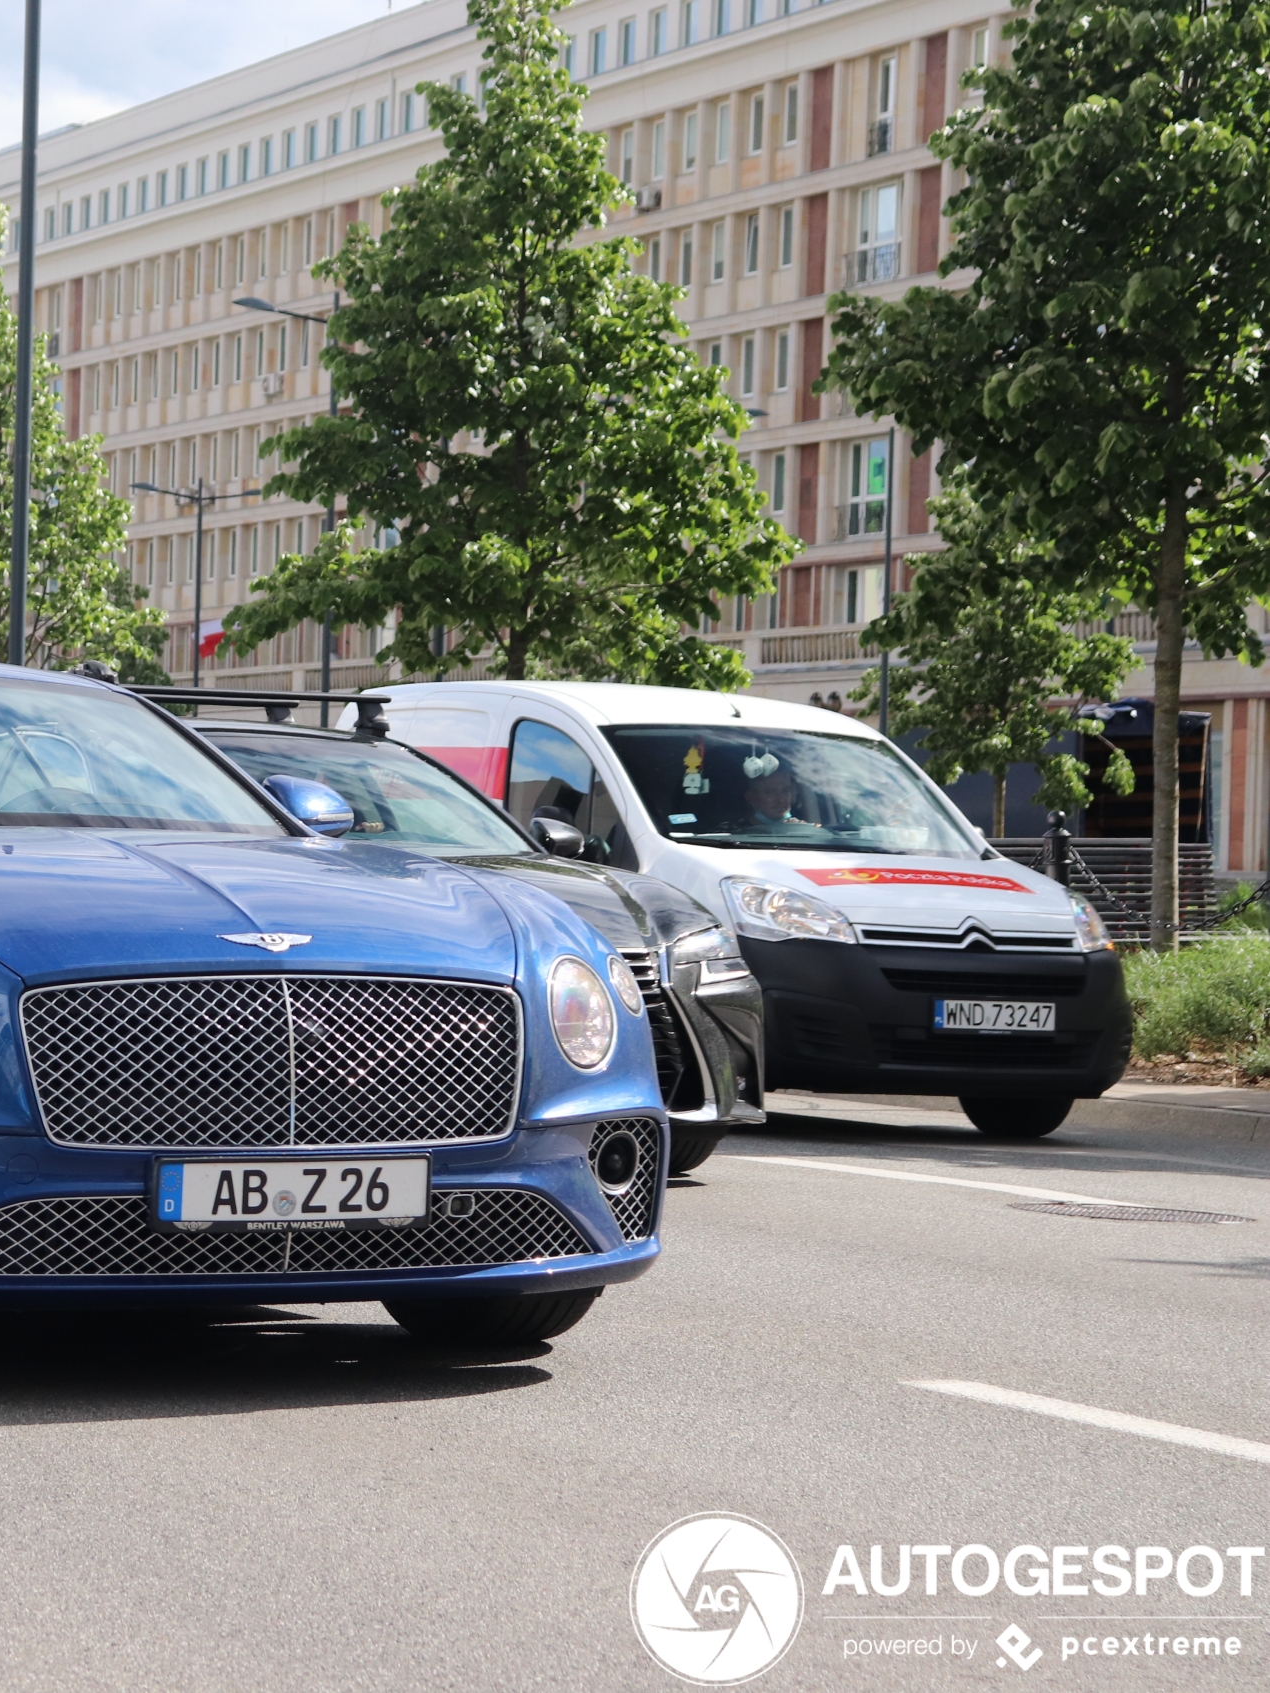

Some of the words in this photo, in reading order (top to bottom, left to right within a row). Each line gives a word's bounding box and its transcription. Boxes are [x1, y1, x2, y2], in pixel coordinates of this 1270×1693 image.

[879, 871, 949, 882] Poczta
[946, 1002, 985, 1026] WND
[991, 1003, 1053, 1028] 73247
[211, 1169, 269, 1215] AB
[301, 1168, 328, 1214] Z
[338, 1166, 390, 1213] 26
[164, 1199, 175, 1212] D
[247, 1221, 289, 1231] BENTLEY
[290, 1220, 346, 1230] WARSZAWA
